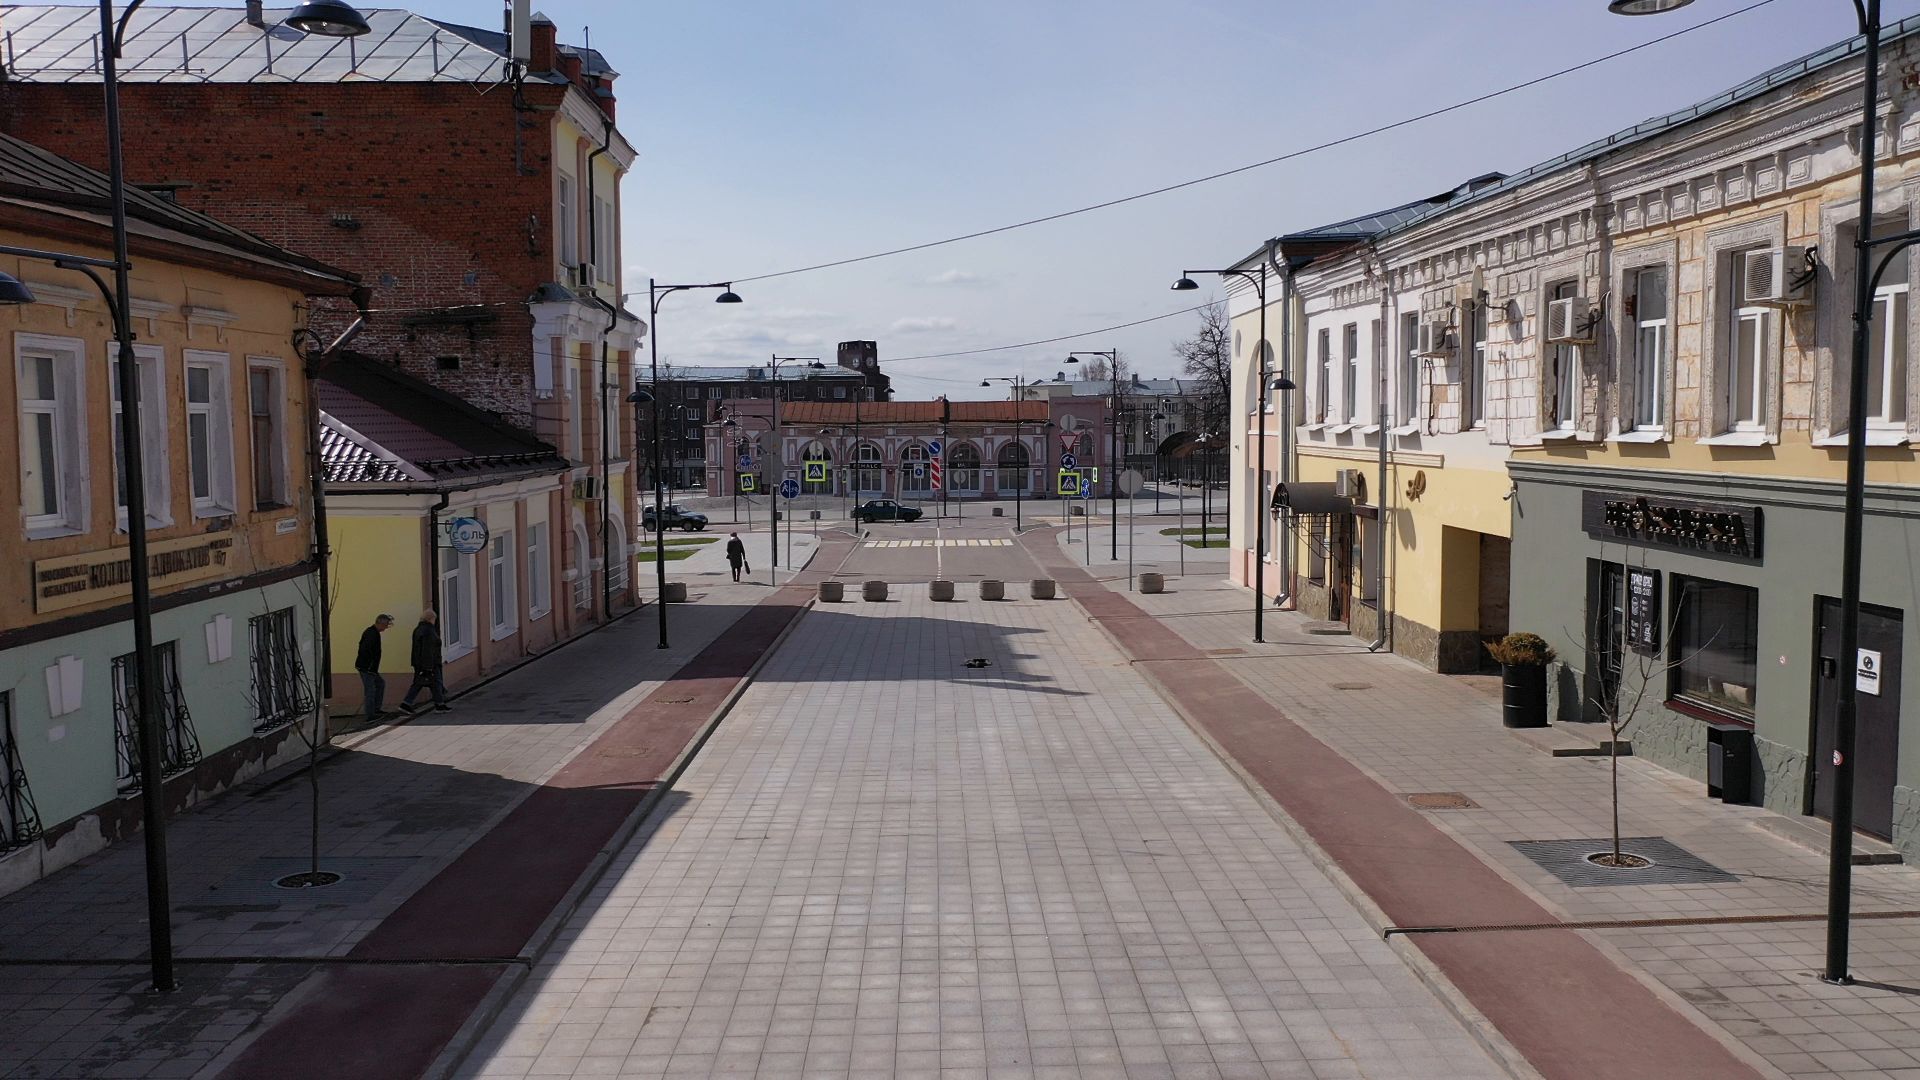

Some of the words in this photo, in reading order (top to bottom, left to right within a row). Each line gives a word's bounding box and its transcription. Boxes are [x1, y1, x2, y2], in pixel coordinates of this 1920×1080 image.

[453, 531, 485, 540] СОЛЬ
[90, 555, 149, 589] КОЛЛЕ
[151, 545, 210, 580] АДВОКАТОВ
[44, 580, 87, 598] ОБЛАСТНАЯ
